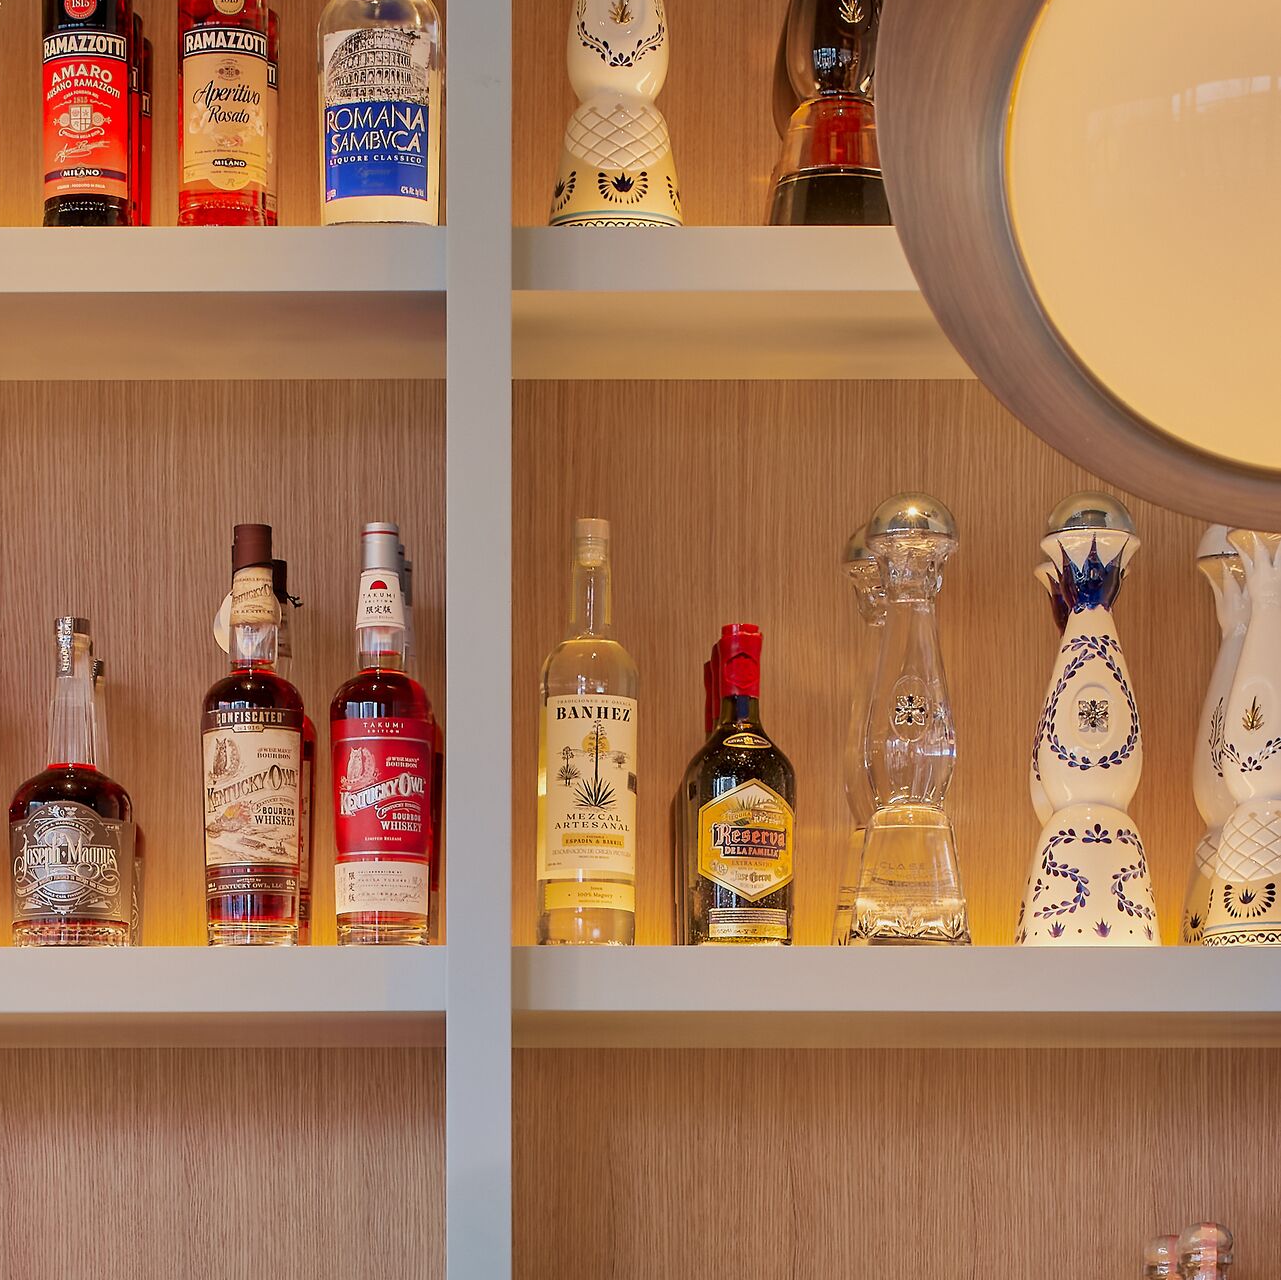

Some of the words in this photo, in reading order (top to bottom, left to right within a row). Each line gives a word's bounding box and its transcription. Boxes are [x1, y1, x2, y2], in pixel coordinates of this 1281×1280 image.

[44, 35, 125, 60] RAMAZZOTTI
[185, 31, 267, 56] RAMAZZOTTI
[51, 63, 113, 86] AMARO
[47, 79, 72, 101] AUSANO
[73, 78, 121, 99] RAMAZZOTTI
[193, 80, 261, 109] Aperitivo
[208, 104, 250, 124] Rosato
[326, 104, 425, 134] ROMANA
[214, 159, 245, 167] MILANO
[329, 155, 369, 166] LIQUORE
[373, 154, 422, 164] CLASSICO
[63, 168, 100, 177] MILANO
[217, 711, 283, 725] CONFISCATED
[556, 706, 631, 722] BANHEZ
[257, 752, 291, 760] BOURBON
[385, 761, 418, 769] BOURBON
[206, 771, 269, 813] KENTUCKY
[339, 777, 399, 816] KENTUCKY
[262, 807, 295, 817] BOURBON
[392, 812, 421, 821] BOURBON
[566, 813, 621, 822] MEZCAL
[255, 815, 296, 827] WHISKEY
[381, 821, 422, 832] WHISKEY
[555, 823, 630, 832] ARTESANAL
[714, 823, 785, 847] Reserva
[724, 846, 736, 855] DE
[737, 847, 747, 855] LA
[748, 847, 778, 858] FAMILIA
